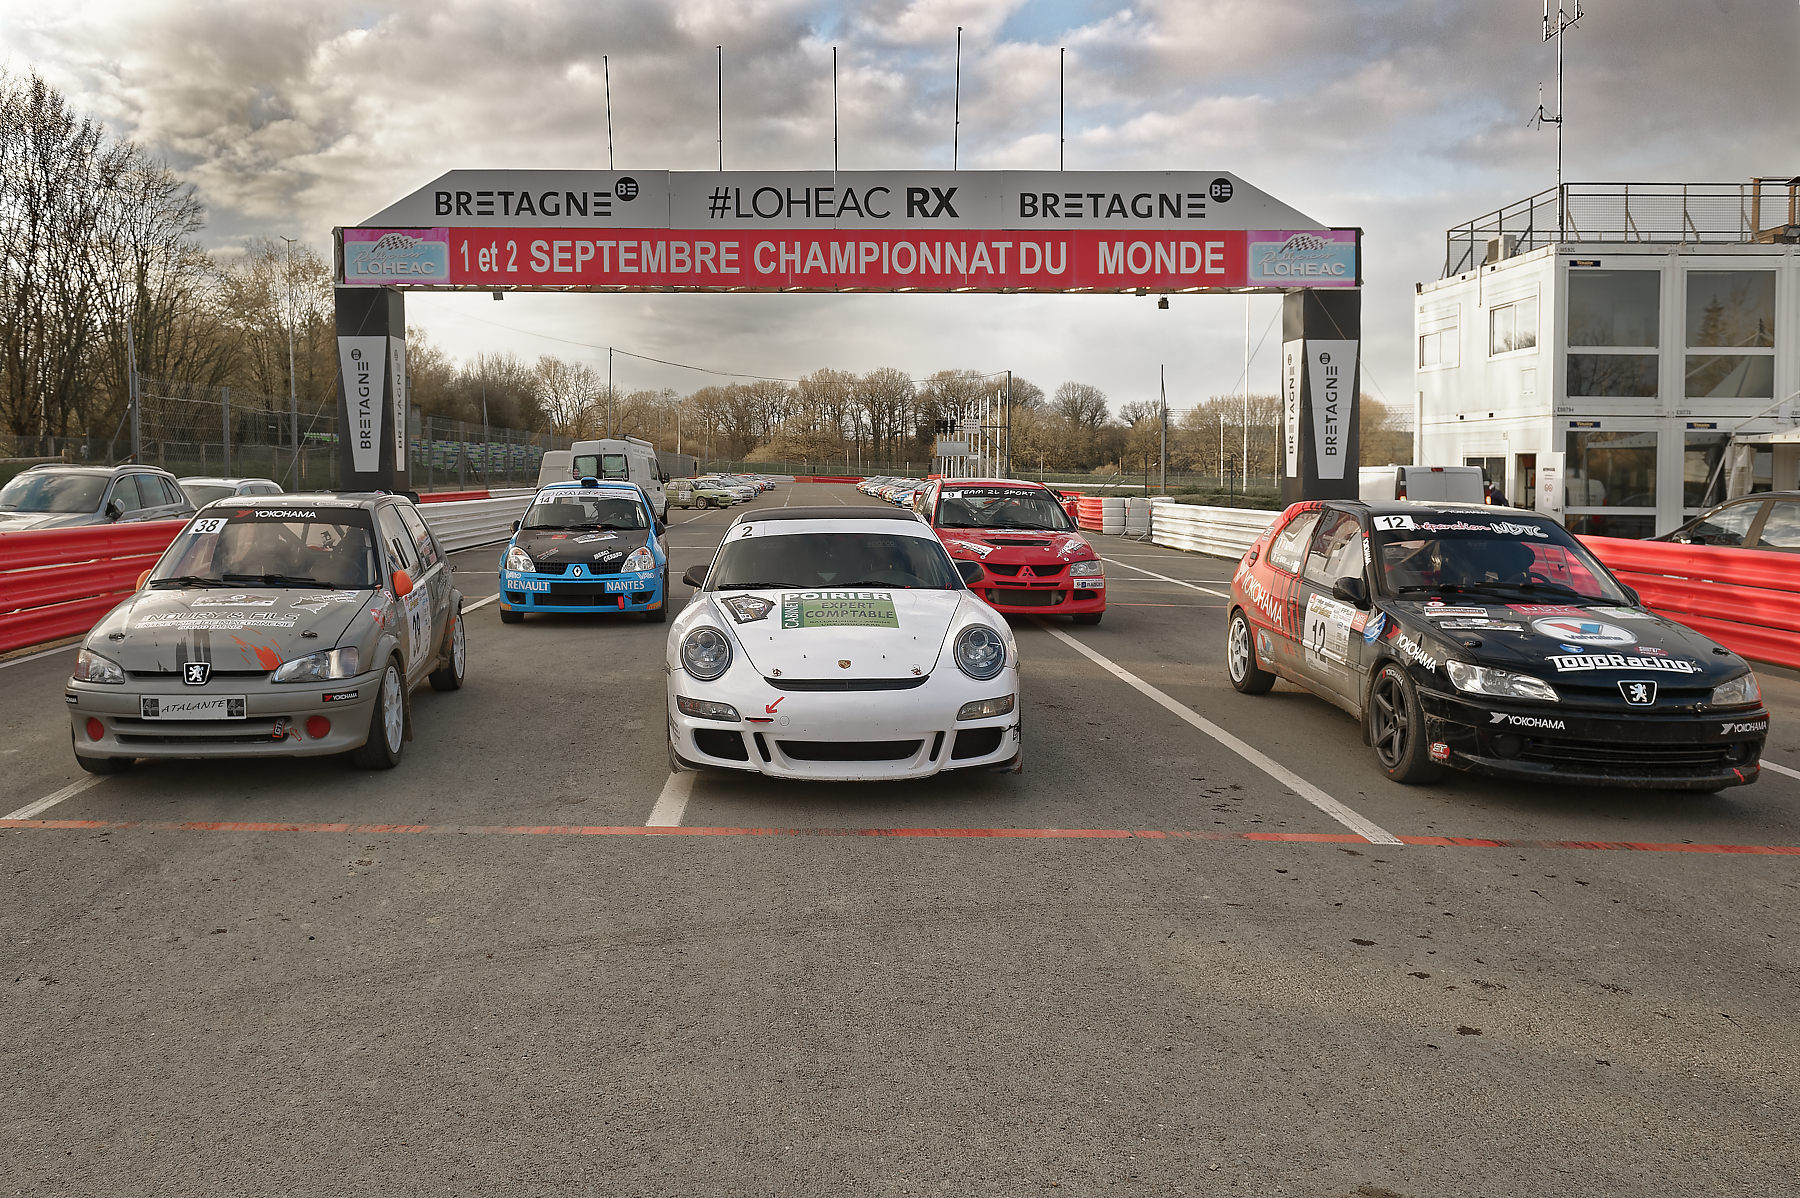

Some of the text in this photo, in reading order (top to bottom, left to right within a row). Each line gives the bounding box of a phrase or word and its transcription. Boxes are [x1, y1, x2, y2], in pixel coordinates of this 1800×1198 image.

[435, 191, 612, 217] BRETAGNE
[708, 186, 959, 219] #LOHEAC RX
[1019, 193, 1206, 219] BRETAGNE
[460, 239, 1225, 275] 1 et 2 SEPTEMBRE CHAMPIONNAT DU MONDE
[357, 261, 435, 275] LOHEAC
[1263, 262, 1345, 276] LOHEAC
[358, 361, 371, 449] BRETAGNE
[1325, 366, 1338, 456] BRETAGNE
[539, 496, 551, 504] 14
[254, 510, 317, 519] YOKOHAMA
[195, 520, 219, 532] 38
[1383, 516, 1407, 528] 12
[741, 526, 753, 537] 2
[507, 580, 550, 592] RENAULT
[606, 581, 645, 592] NANTES
[784, 592, 892, 601] POIRIER
[1242, 570, 1283, 628] YOKOHAMA
[227, 611, 245, 619] &
[248, 611, 301, 622] FILS
[784, 601, 800, 629] CABINET
[805, 610, 894, 619] COMPTABLE
[1312, 619, 1329, 664] 12
[1396, 633, 1437, 674] YOKOHAMA
[1507, 714, 1565, 730] YOKOHAMA
[1733, 720, 1767, 733] YOKOHAMA
